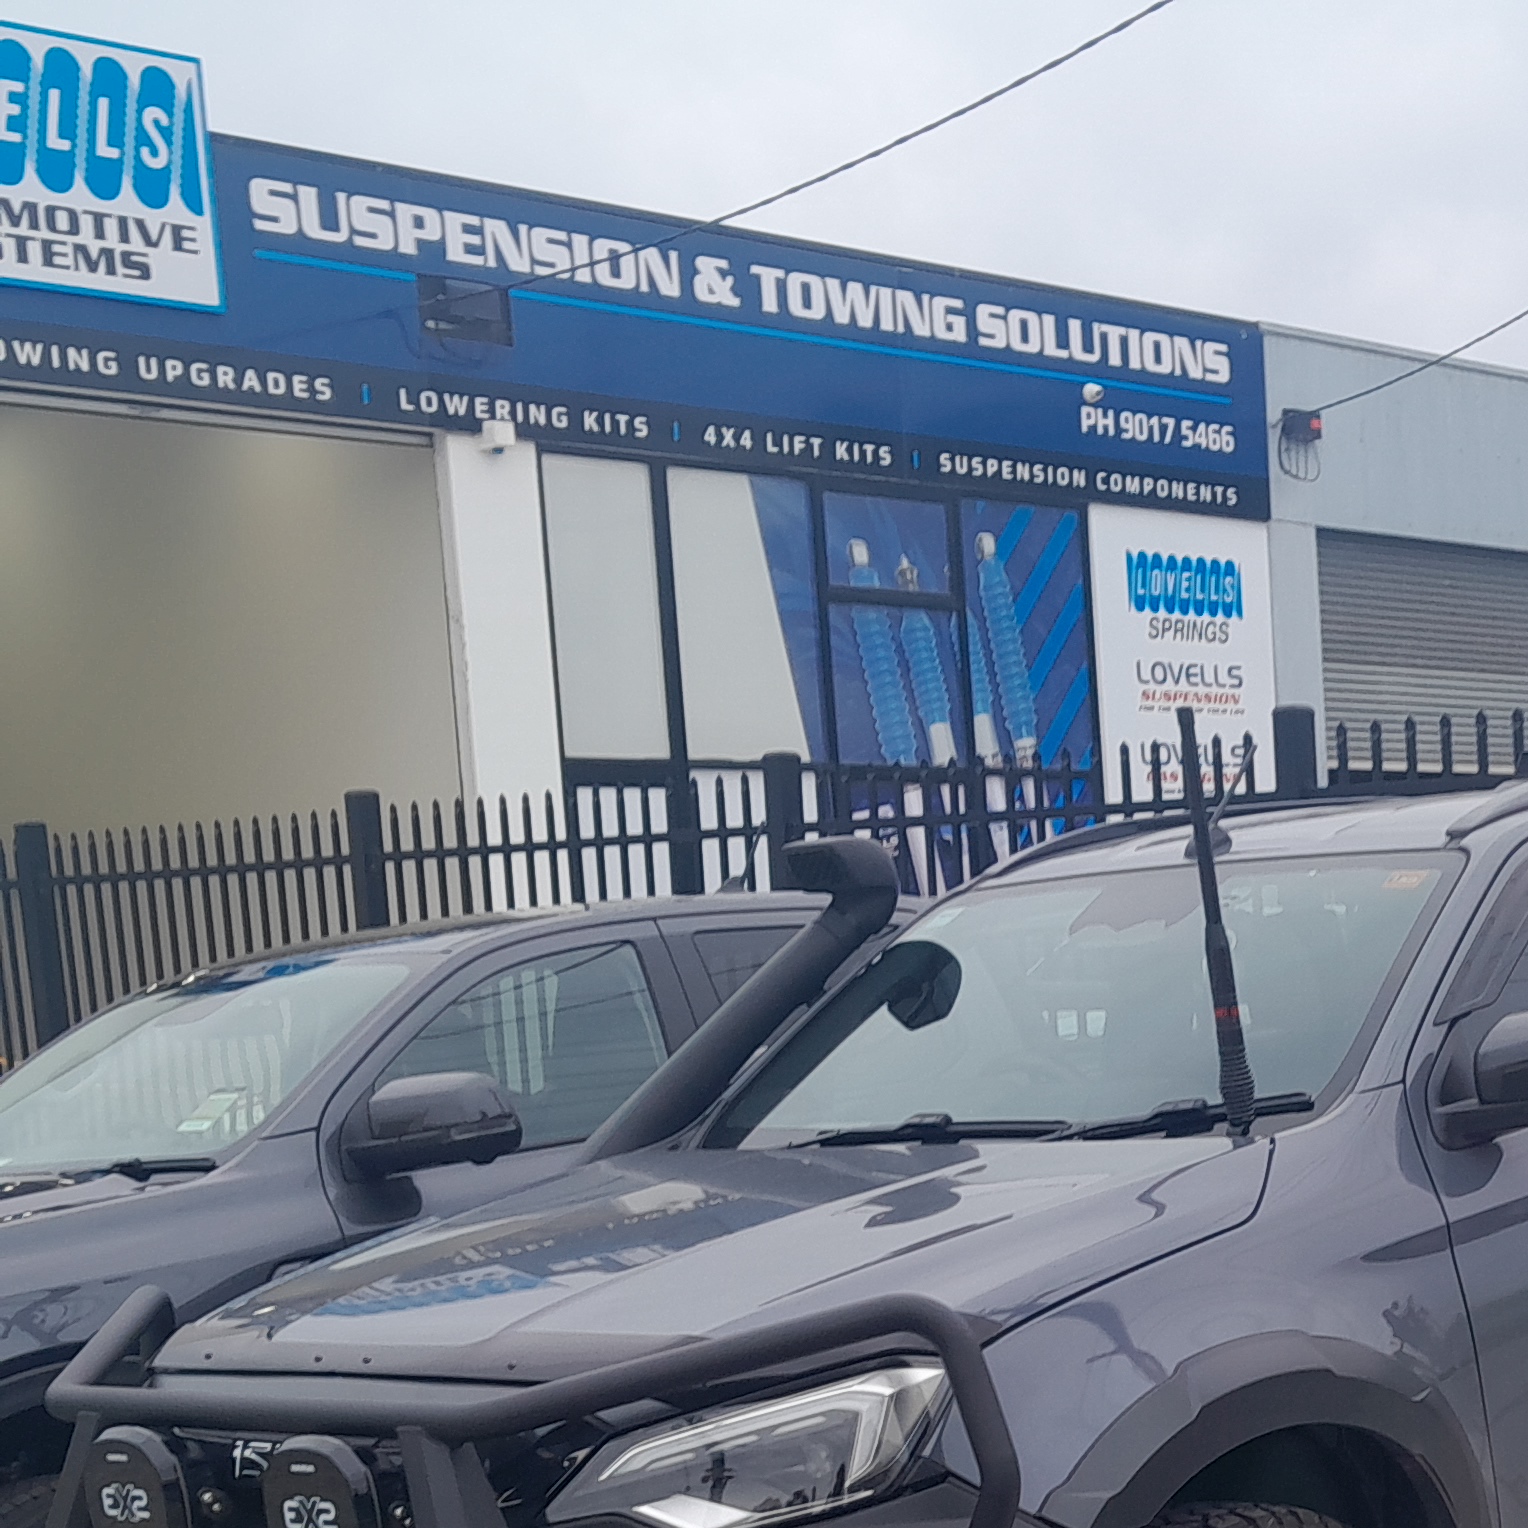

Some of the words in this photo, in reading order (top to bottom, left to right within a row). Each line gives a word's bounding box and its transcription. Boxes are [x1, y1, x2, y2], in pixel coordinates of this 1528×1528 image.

[0, 232, 152, 280] TEMS
[248, 176, 682, 298] SUSPENSION
[694, 255, 740, 307] &
[749, 264, 967, 343] TOWING
[975, 303, 1231, 383] SOLUTIONS
[138, 355, 332, 401] UPGRADES
[399, 387, 569, 429] LOWERING
[583, 409, 649, 438] KITS
[1080, 405, 1115, 437] PH
[1119, 411, 1176, 445] 9017
[1180, 419, 1236, 454] 5466
[703, 424, 753, 450] 4X4
[766, 431, 824, 459] LIFT
[835, 440, 893, 466] KITS
[938, 453, 1086, 489] SUSPENSION
[1096, 471, 1238, 507] COMPONENTS
[1136, 567, 1235, 603] LOVELLS
[1148, 616, 1230, 644] SPRINGS
[1136, 659, 1244, 689] LOVELLS
[1141, 689, 1241, 705] SUSPENSION
